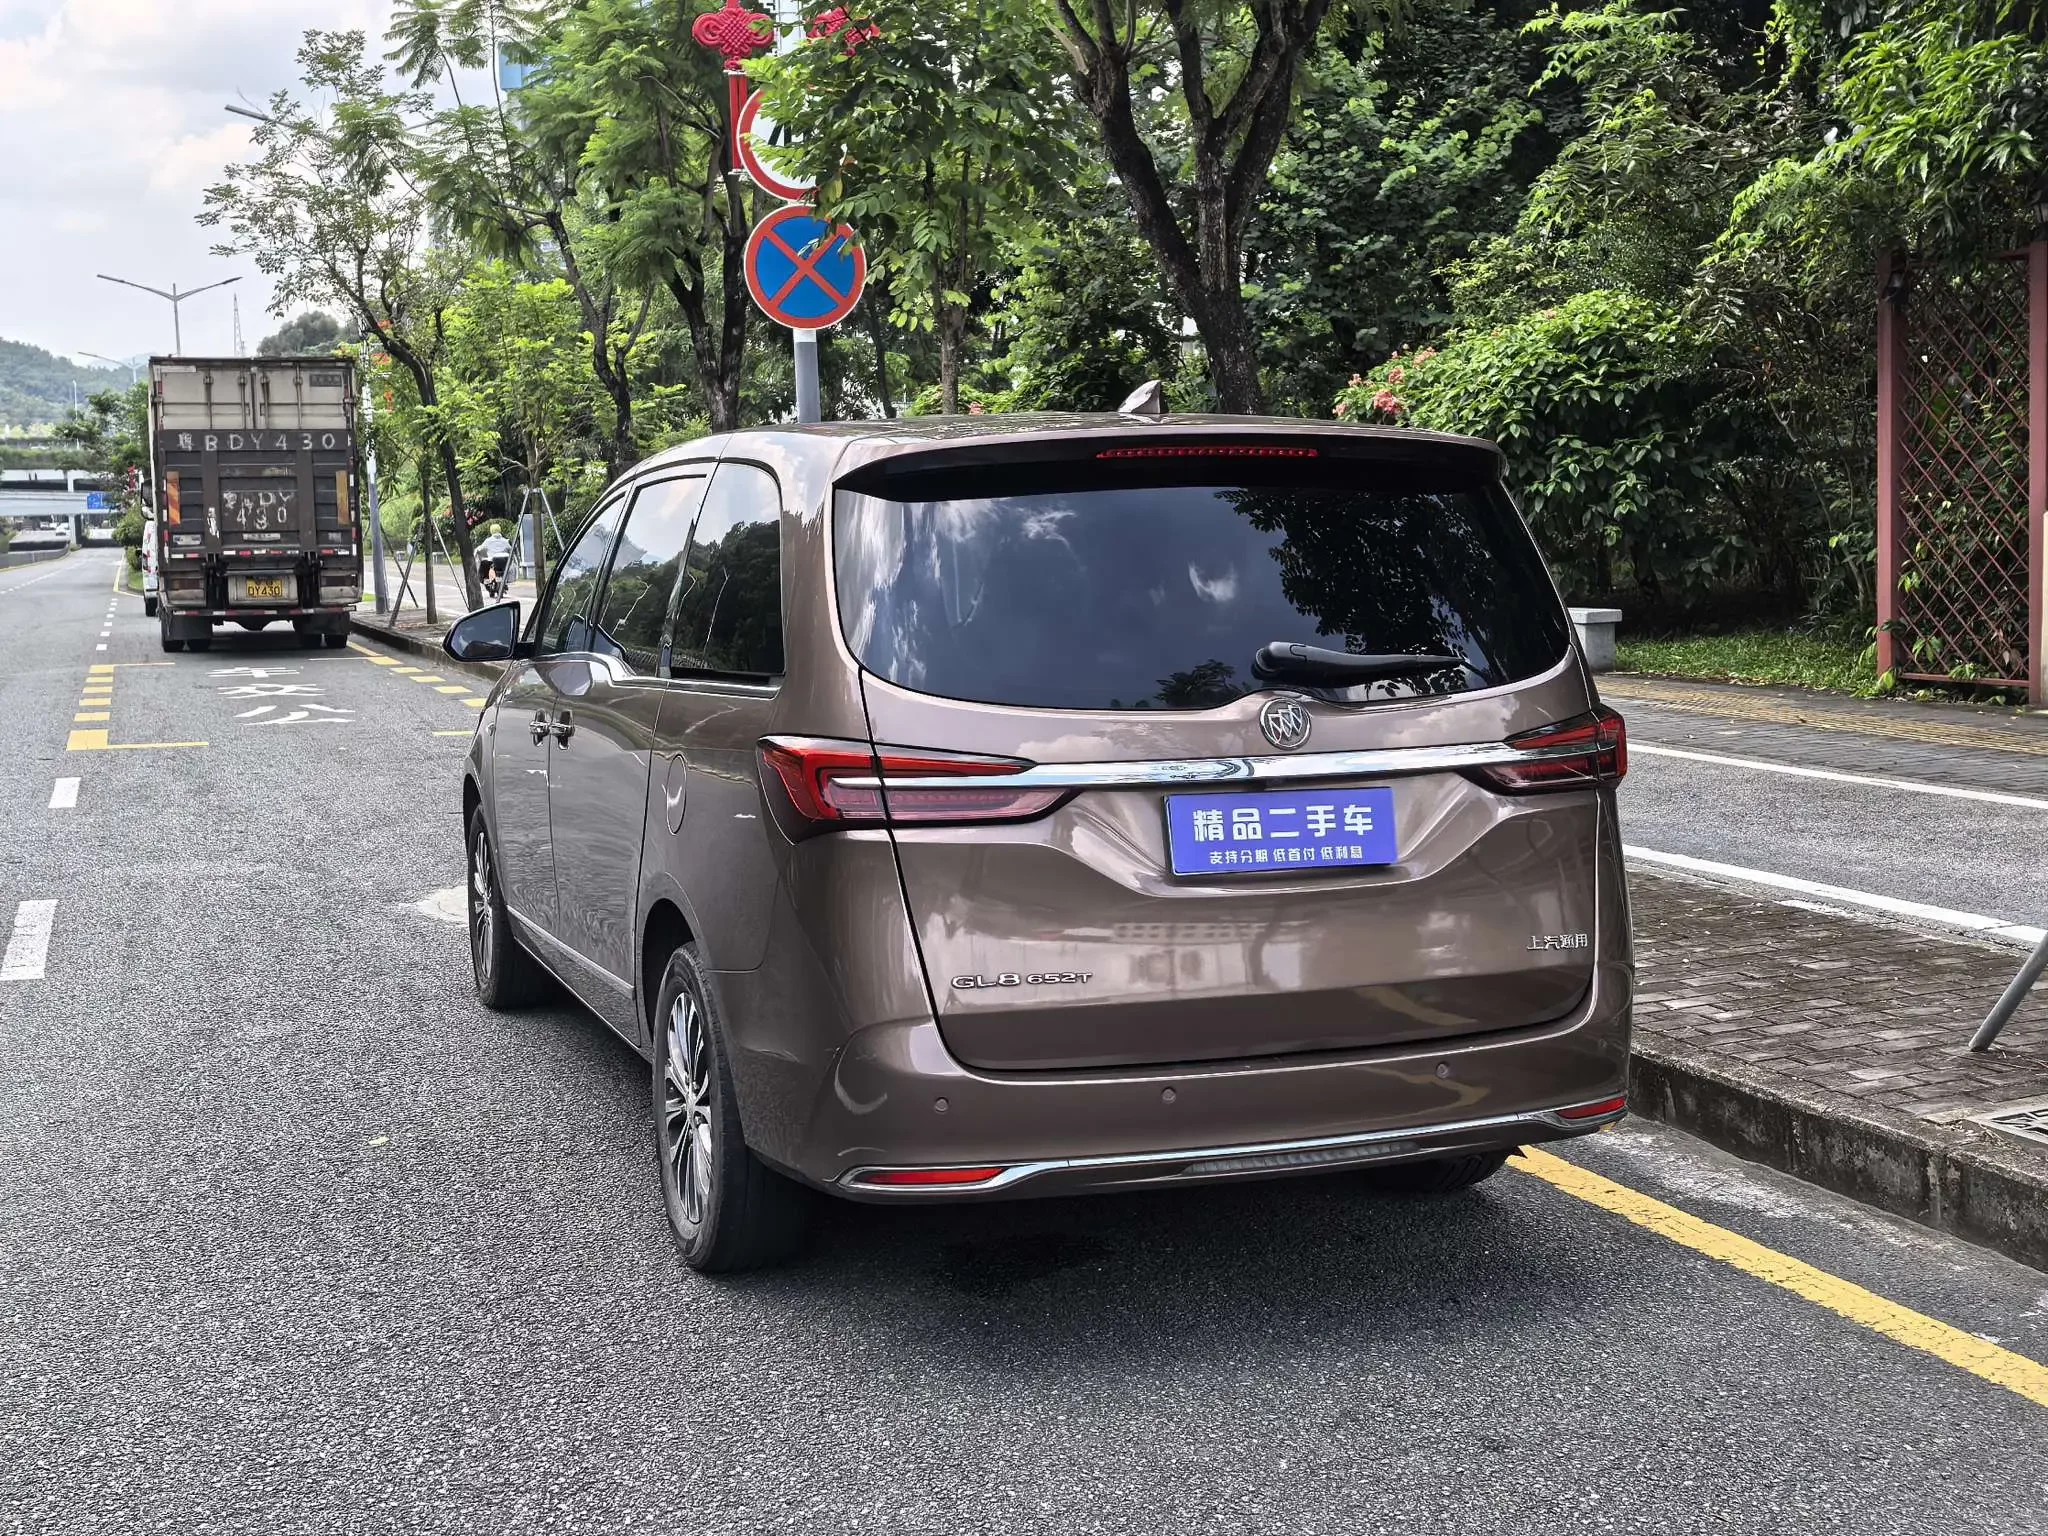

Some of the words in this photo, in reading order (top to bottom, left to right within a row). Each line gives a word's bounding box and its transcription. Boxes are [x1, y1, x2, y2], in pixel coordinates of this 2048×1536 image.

[1192, 804, 1374, 842] 精品二手车
[1209, 849, 1268, 865] 支持分期
[1273, 847, 1315, 863] 低首付
[1526, 933, 1588, 951] 上汽通用
[951, 972, 1021, 989] GL8
[1026, 971, 1093, 985] 652T
